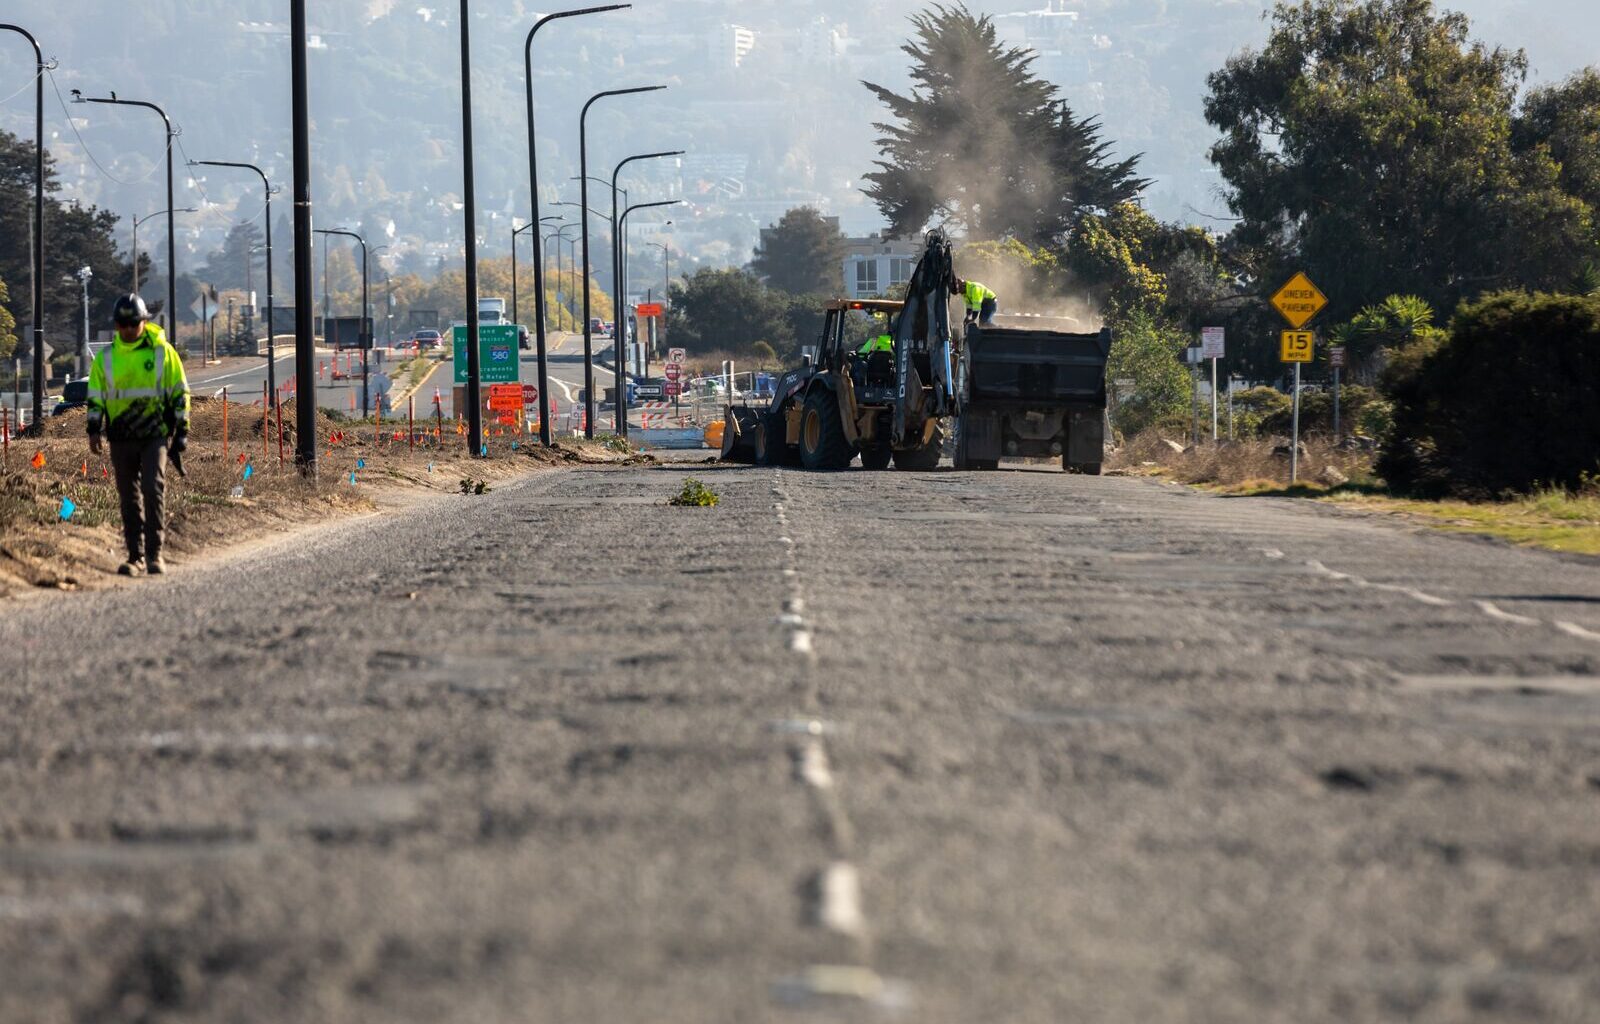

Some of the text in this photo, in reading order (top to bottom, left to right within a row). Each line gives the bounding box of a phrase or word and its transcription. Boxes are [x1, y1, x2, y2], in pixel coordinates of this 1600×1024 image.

[1283, 289, 1315, 299] UNEVEN
[1287, 334, 1308, 350] 15
[492, 351, 509, 360] 580
